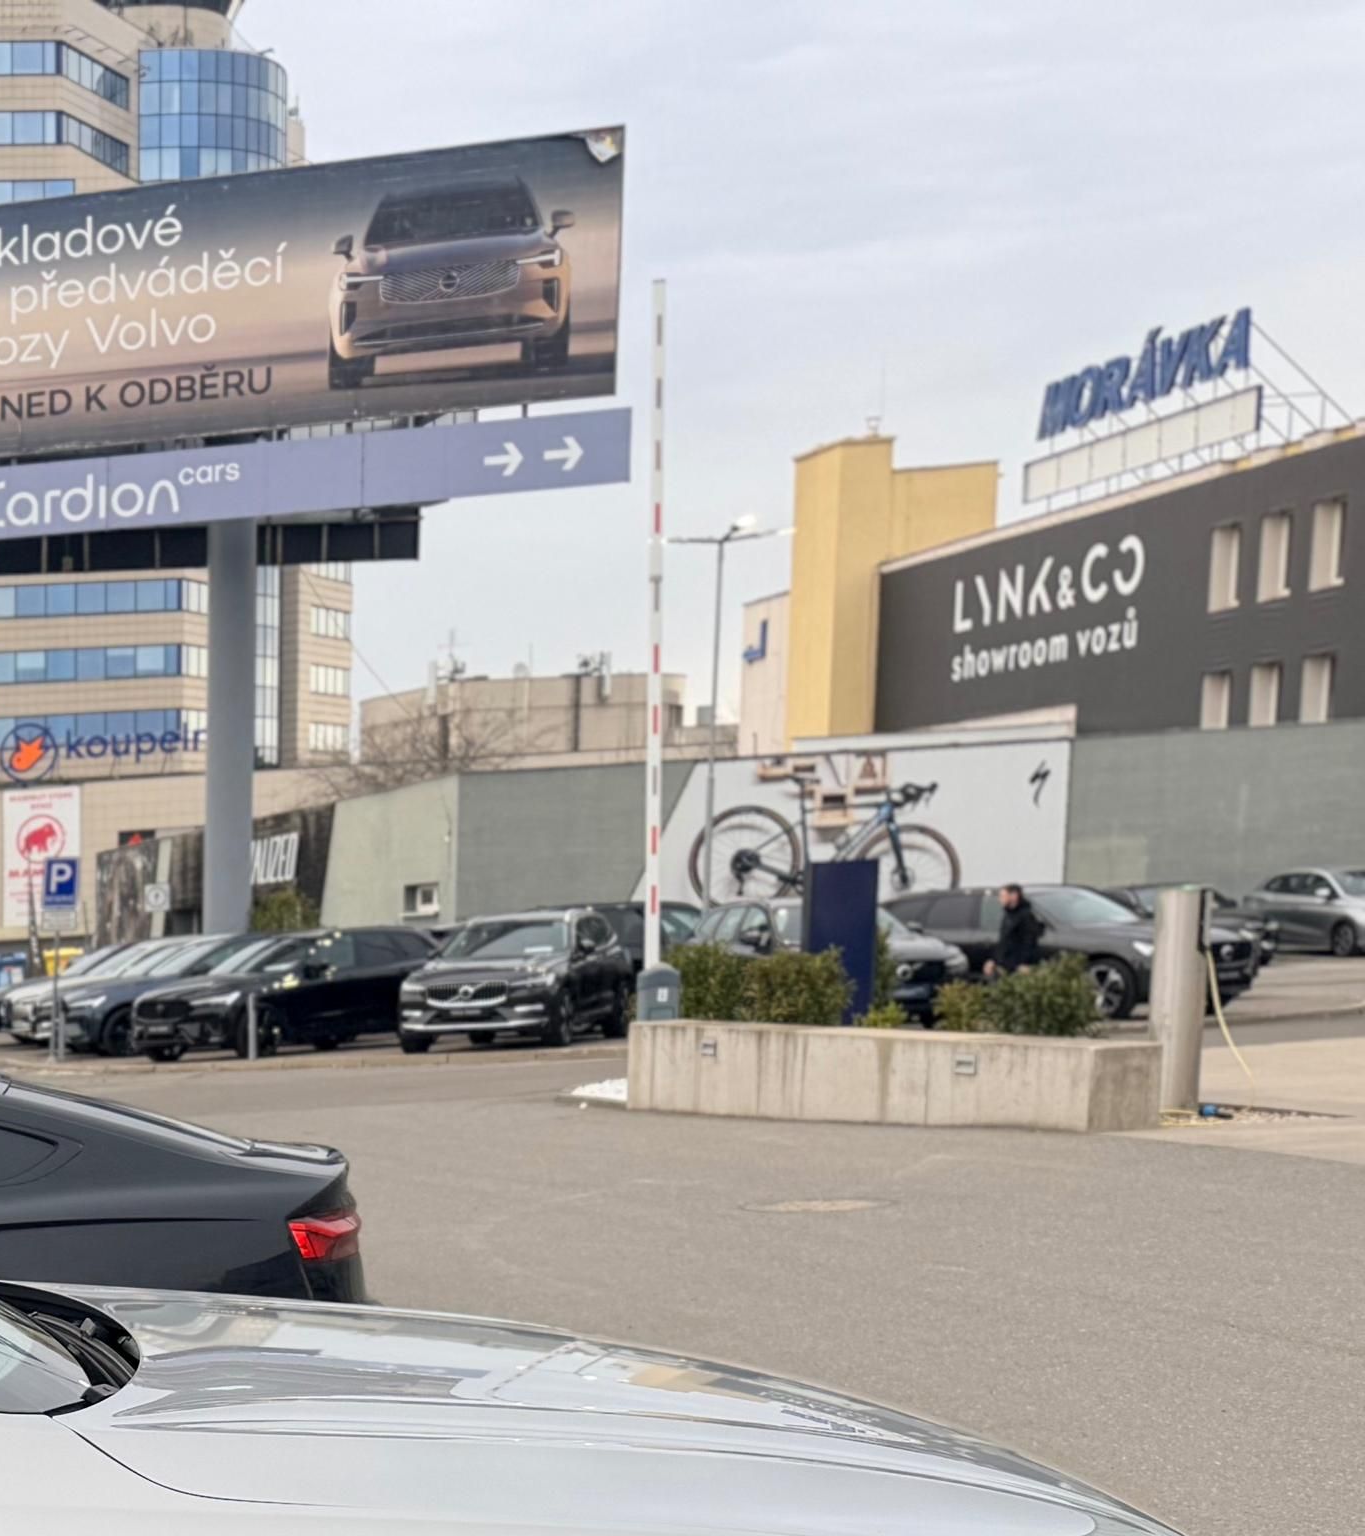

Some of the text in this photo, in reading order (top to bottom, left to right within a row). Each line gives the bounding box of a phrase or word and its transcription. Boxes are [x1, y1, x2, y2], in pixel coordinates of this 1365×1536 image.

[10, 241, 288, 324] předváděcí
[85, 308, 217, 354] Volvo
[84, 383, 108, 413] K
[119, 364, 273, 408] ODBĚRU
[1036, 306, 1252, 441] MORÁVKA
[178, 462, 241, 485] cars
[950, 606, 1139, 682] showroom vozů
[50, 862, 73, 893] P
